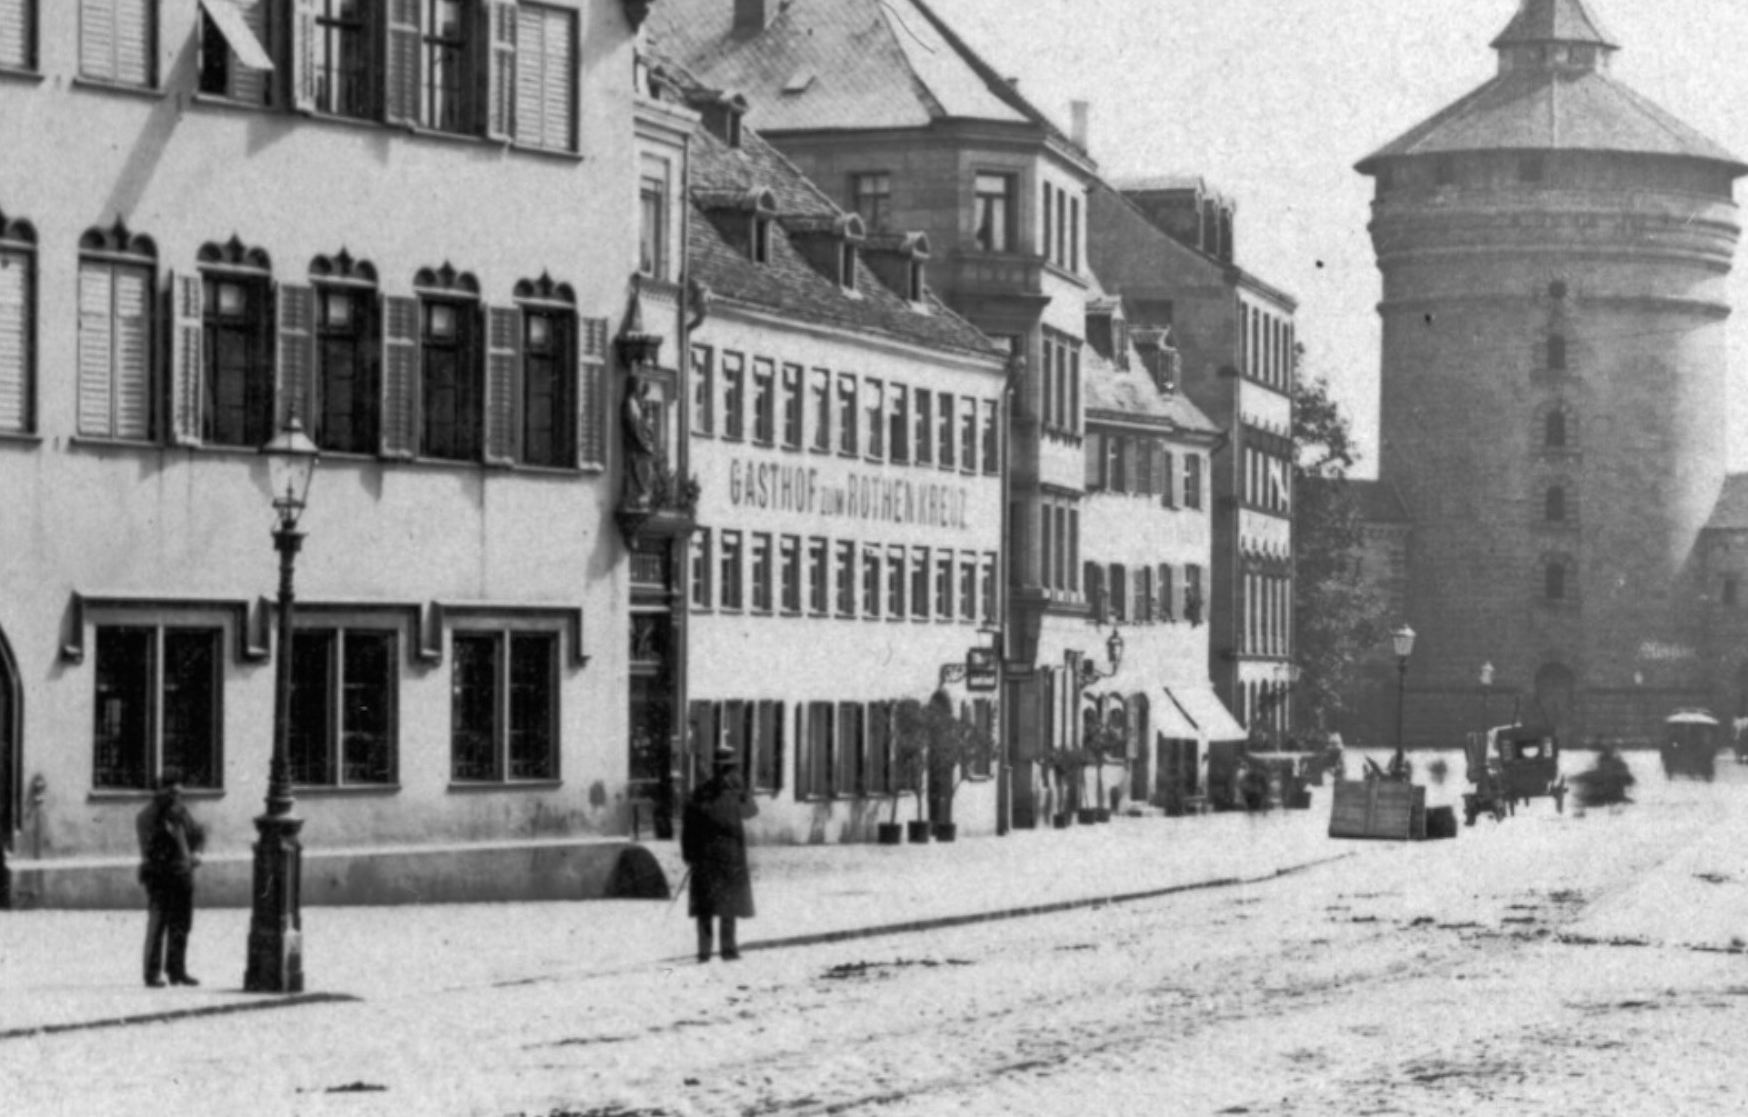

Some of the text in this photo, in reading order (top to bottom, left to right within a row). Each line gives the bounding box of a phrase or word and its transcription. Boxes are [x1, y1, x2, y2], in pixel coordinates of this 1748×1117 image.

[730, 458, 818, 514] GASTHOF
[848, 471, 914, 524] ROTHEN
[917, 483, 967, 529] KREUZ
